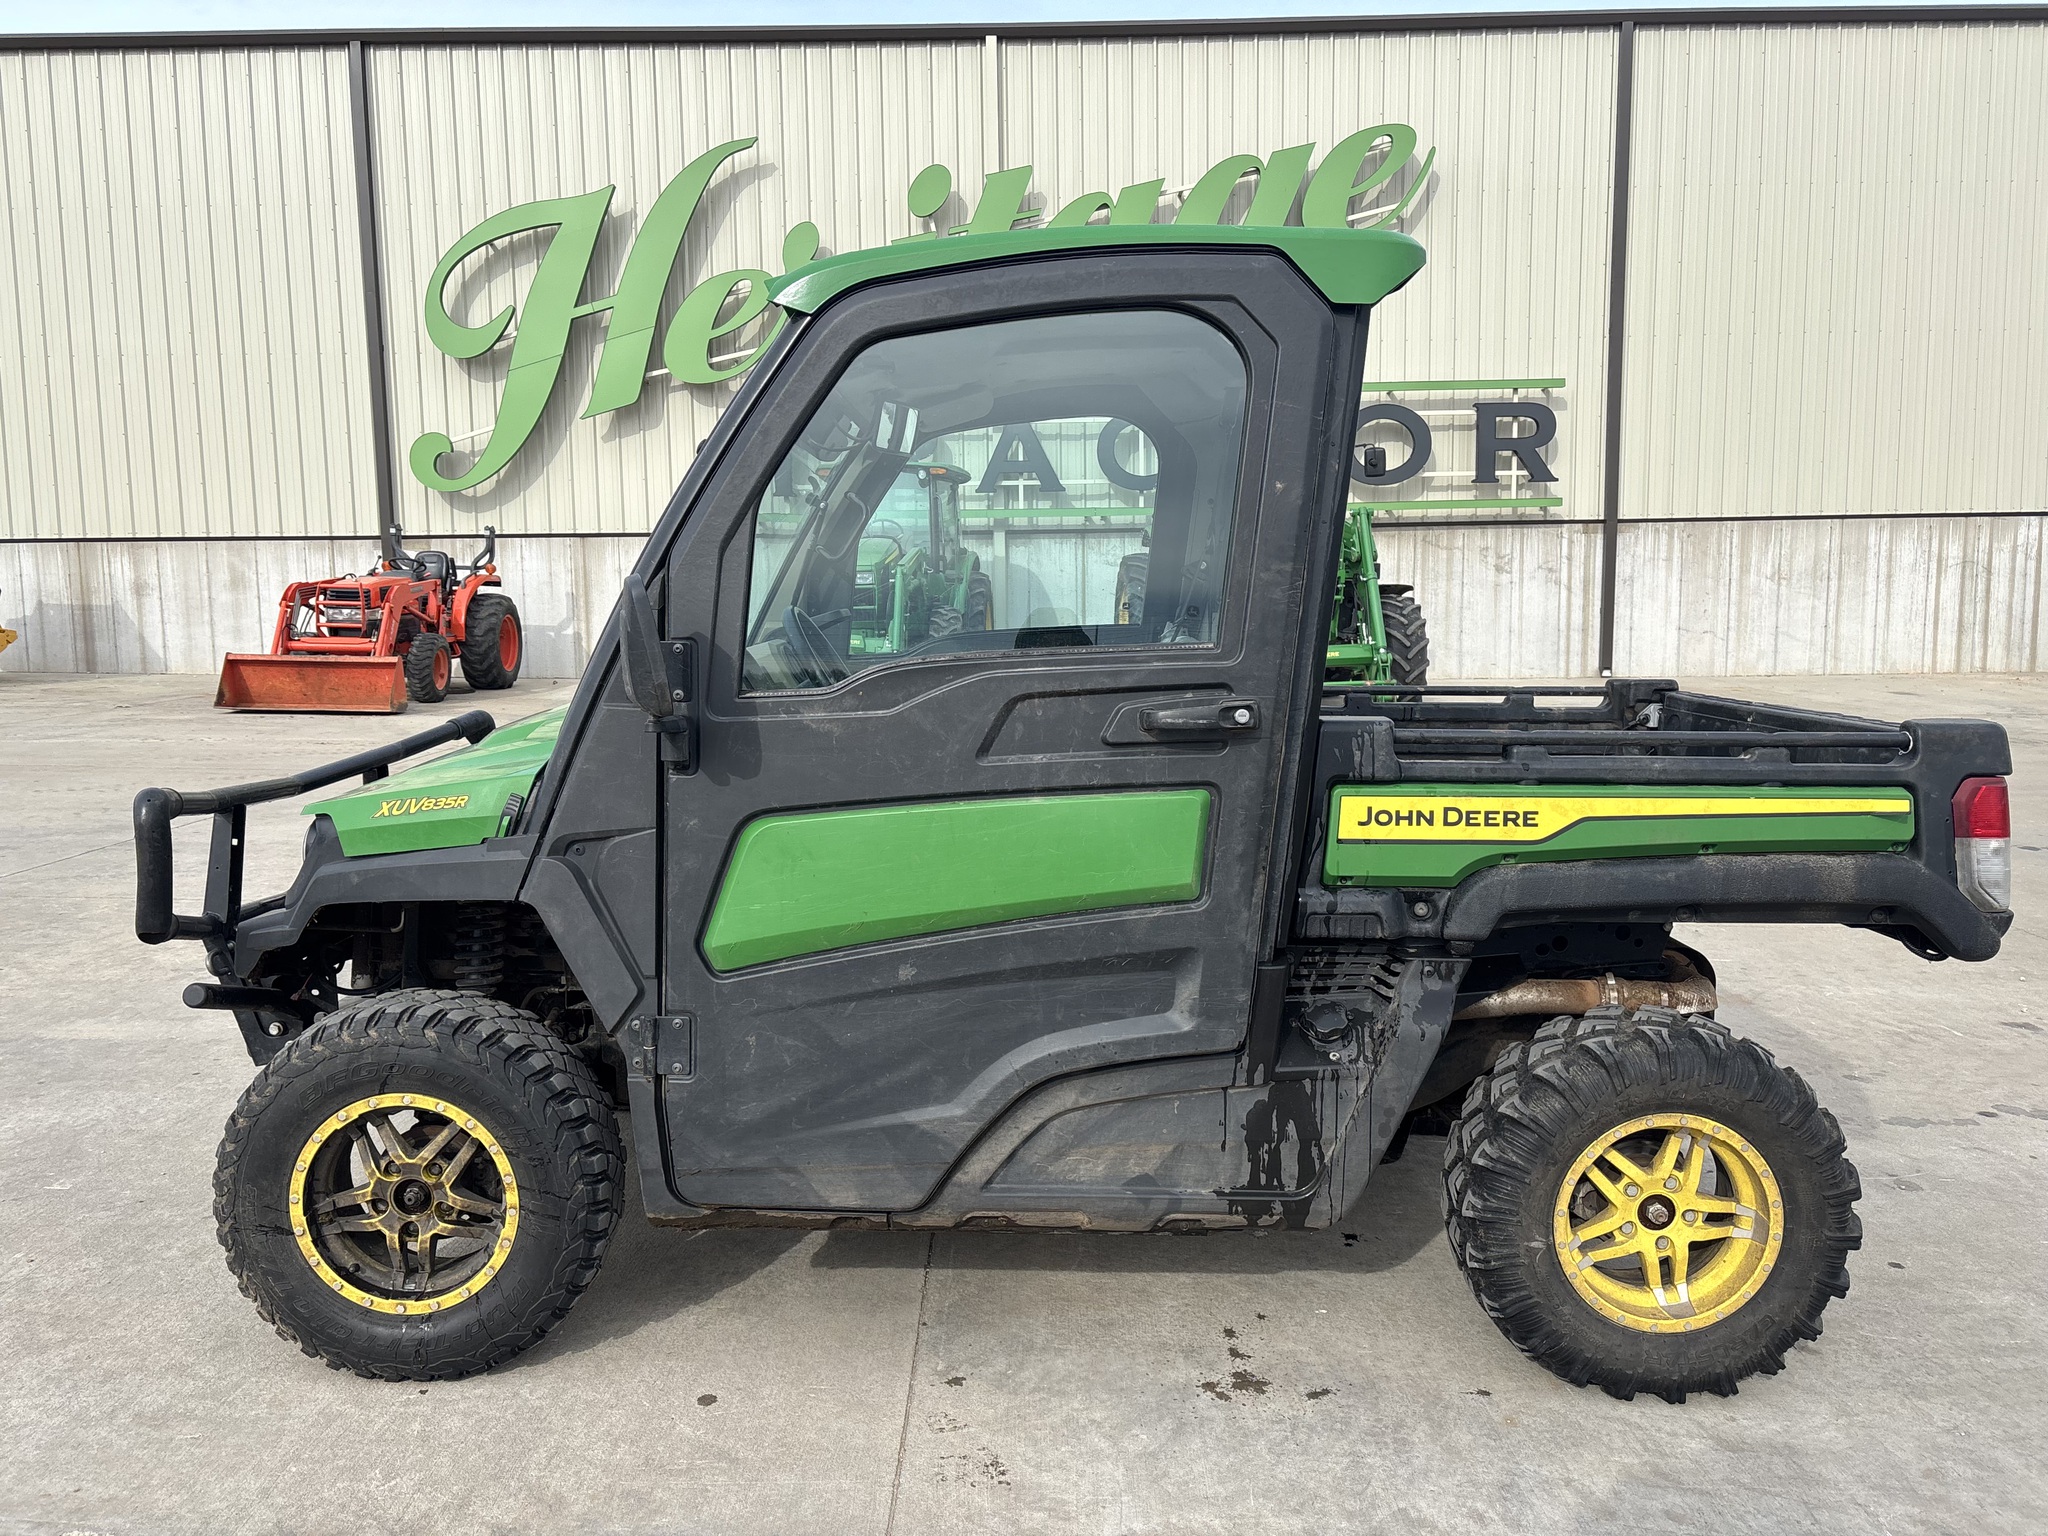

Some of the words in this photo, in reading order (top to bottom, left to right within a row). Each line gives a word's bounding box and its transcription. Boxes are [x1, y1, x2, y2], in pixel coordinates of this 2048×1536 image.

[409, 122, 1437, 492] Hete
[772, 401, 1559, 496] ACOR
[370, 794, 470, 820] XUV835R
[1357, 806, 1435, 827] JOHN
[1442, 806, 1539, 828] DEERE
[298, 1061, 533, 1149] BFGoodrich
